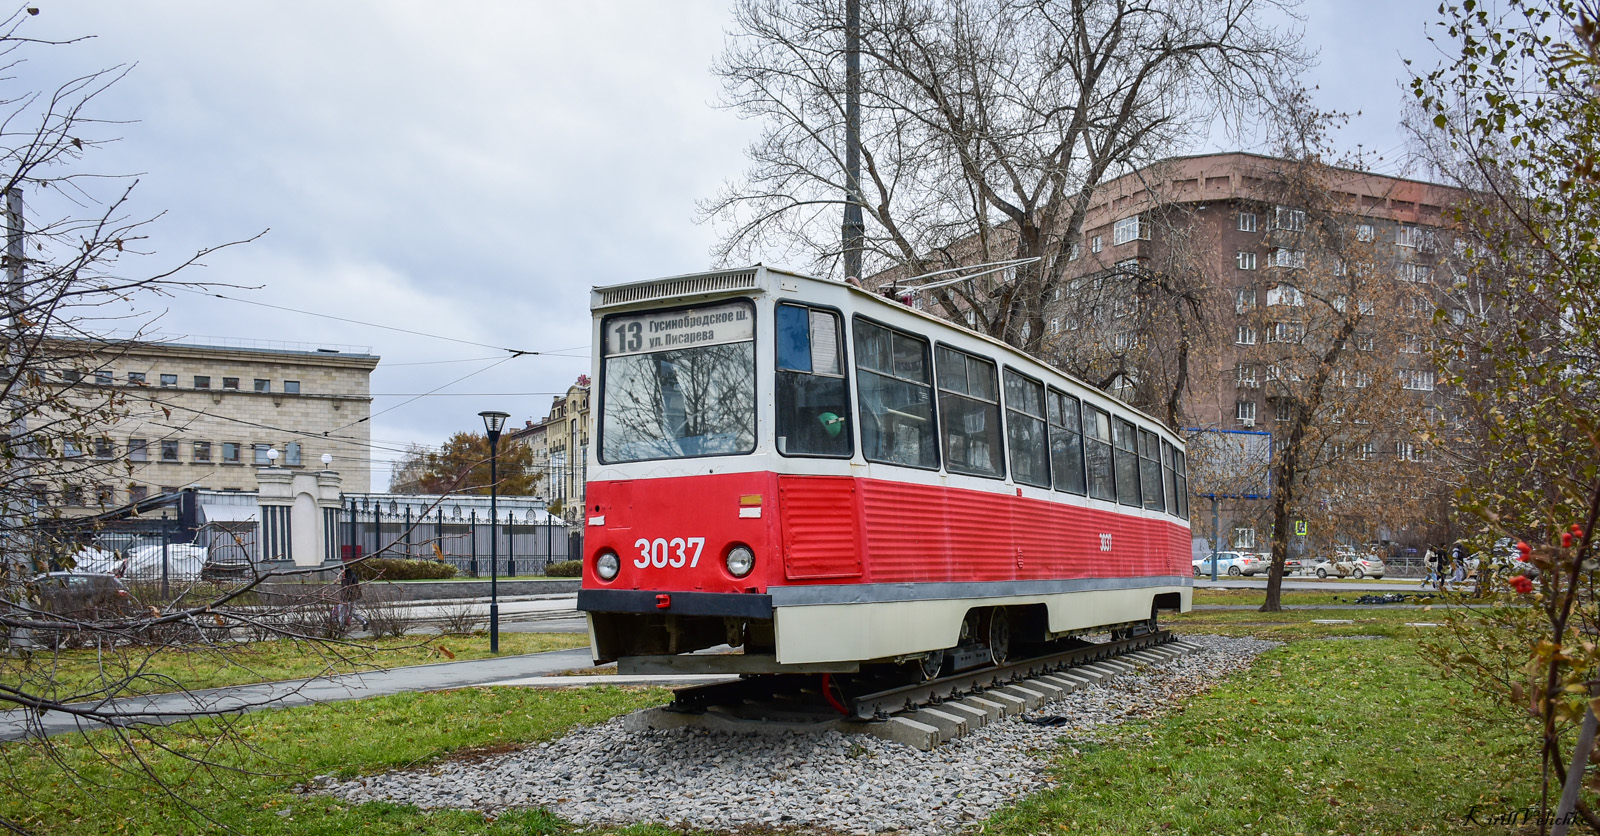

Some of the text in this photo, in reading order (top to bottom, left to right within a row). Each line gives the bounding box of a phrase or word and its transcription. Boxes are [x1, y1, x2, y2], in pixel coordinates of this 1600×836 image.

[650, 313, 734, 333] Гусинобродское
[615, 322, 643, 353] 13
[649, 329, 714, 348] ул. Писарева
[1099, 533, 1112, 551] 3037
[633, 537, 705, 569] 3037
